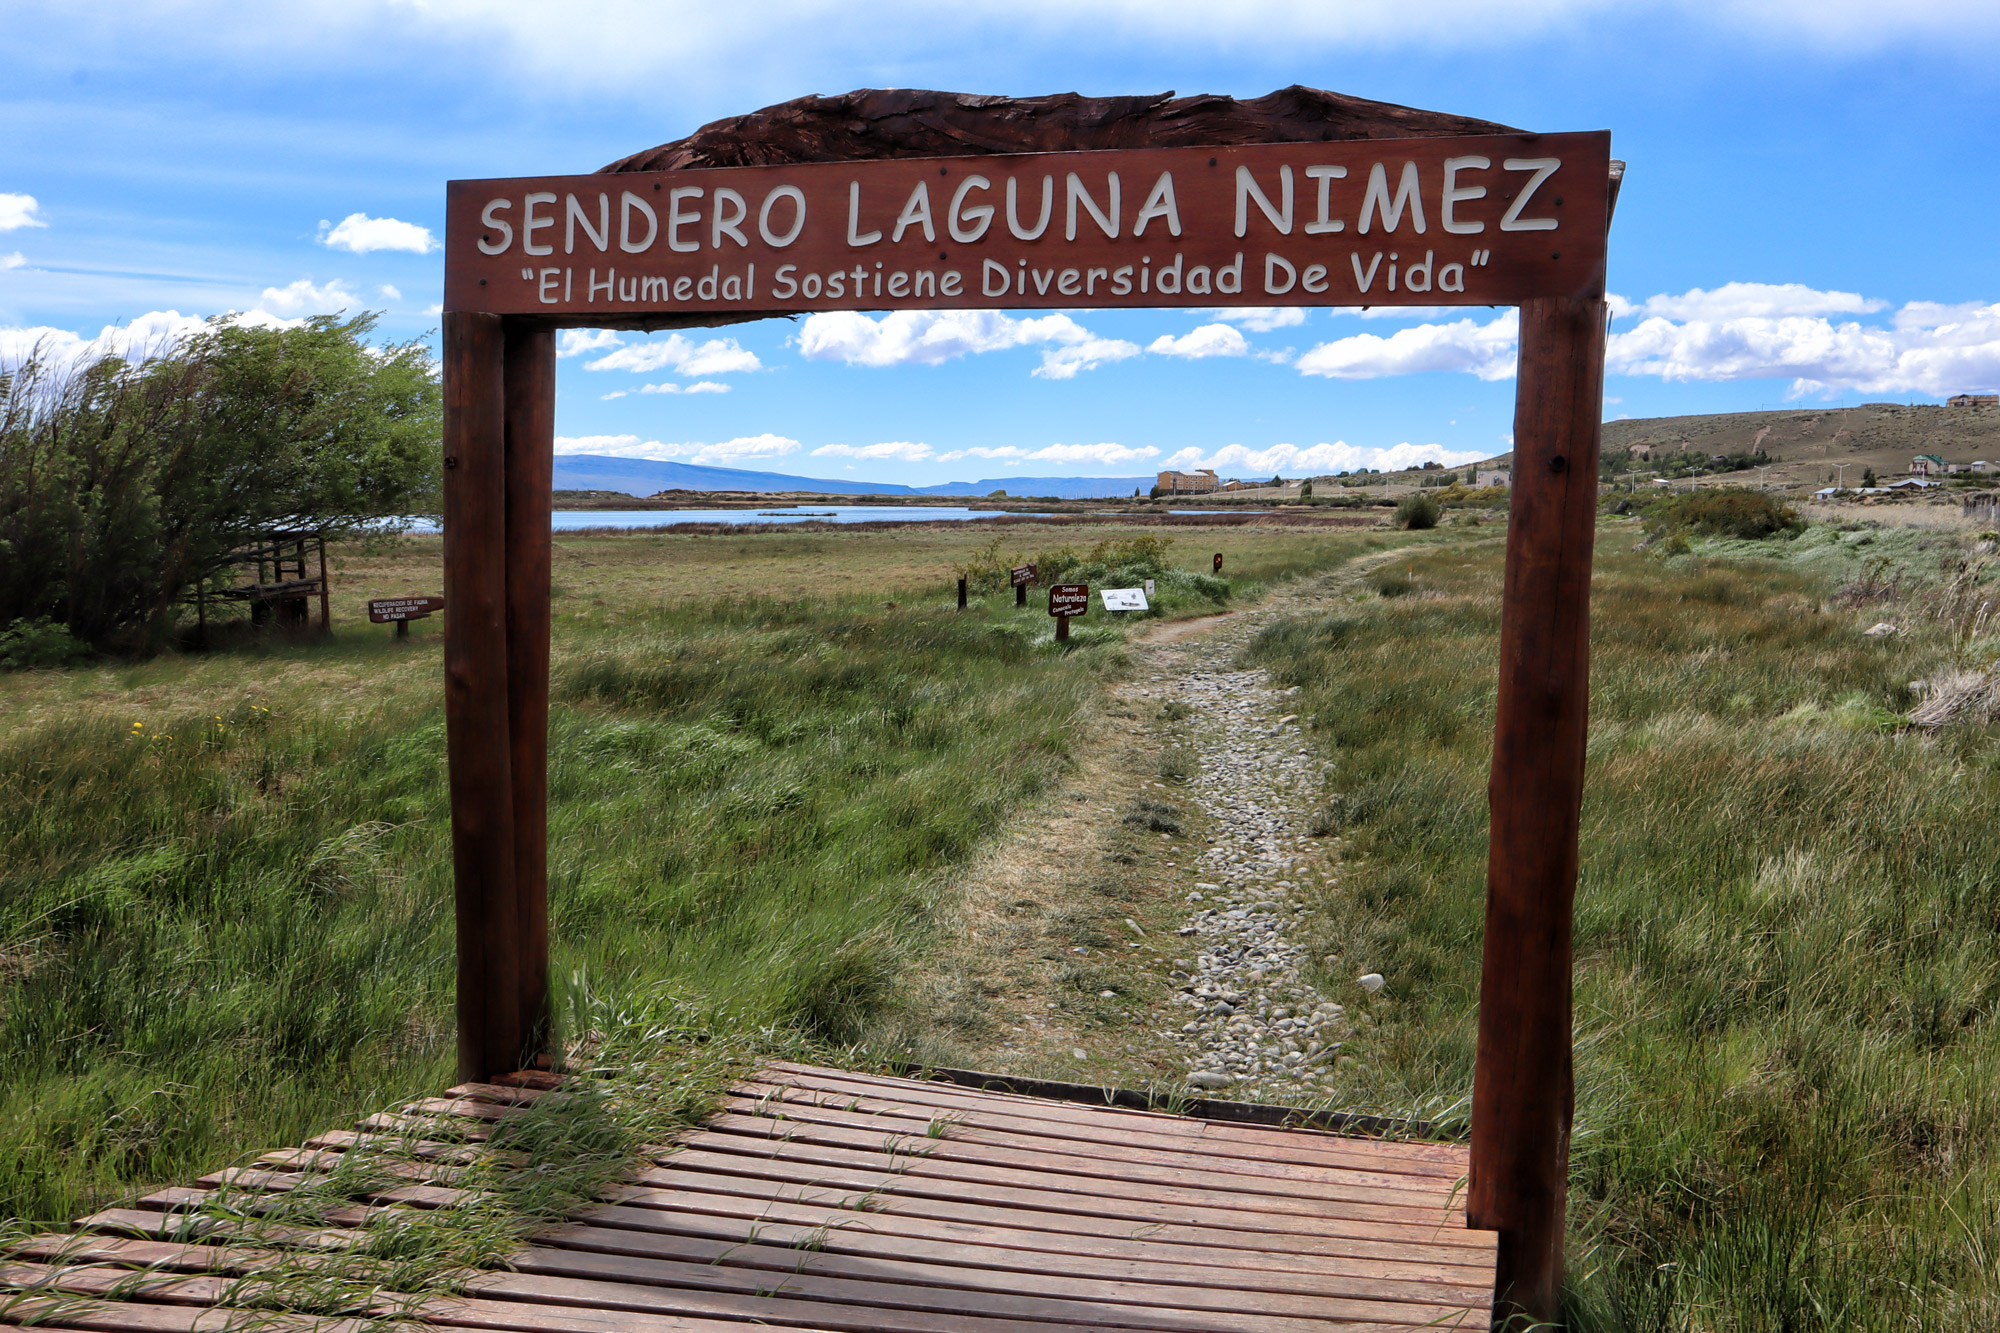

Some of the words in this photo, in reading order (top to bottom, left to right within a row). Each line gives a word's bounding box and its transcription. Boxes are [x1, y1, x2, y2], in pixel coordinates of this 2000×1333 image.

[477, 185, 806, 256] SENDERO
[847, 172, 1183, 247] LAGUNA
[1234, 156, 1561, 238] NIMEZ
[521, 266, 572, 304] "El
[588, 262, 755, 303] Humedal
[772, 261, 963, 299] Sostiene
[982, 251, 1244, 297] Diversidad
[1264, 252, 1329, 295] De
[1350, 249, 1490, 293] Vida"
[1052, 593, 1087, 604] Naturaleza
